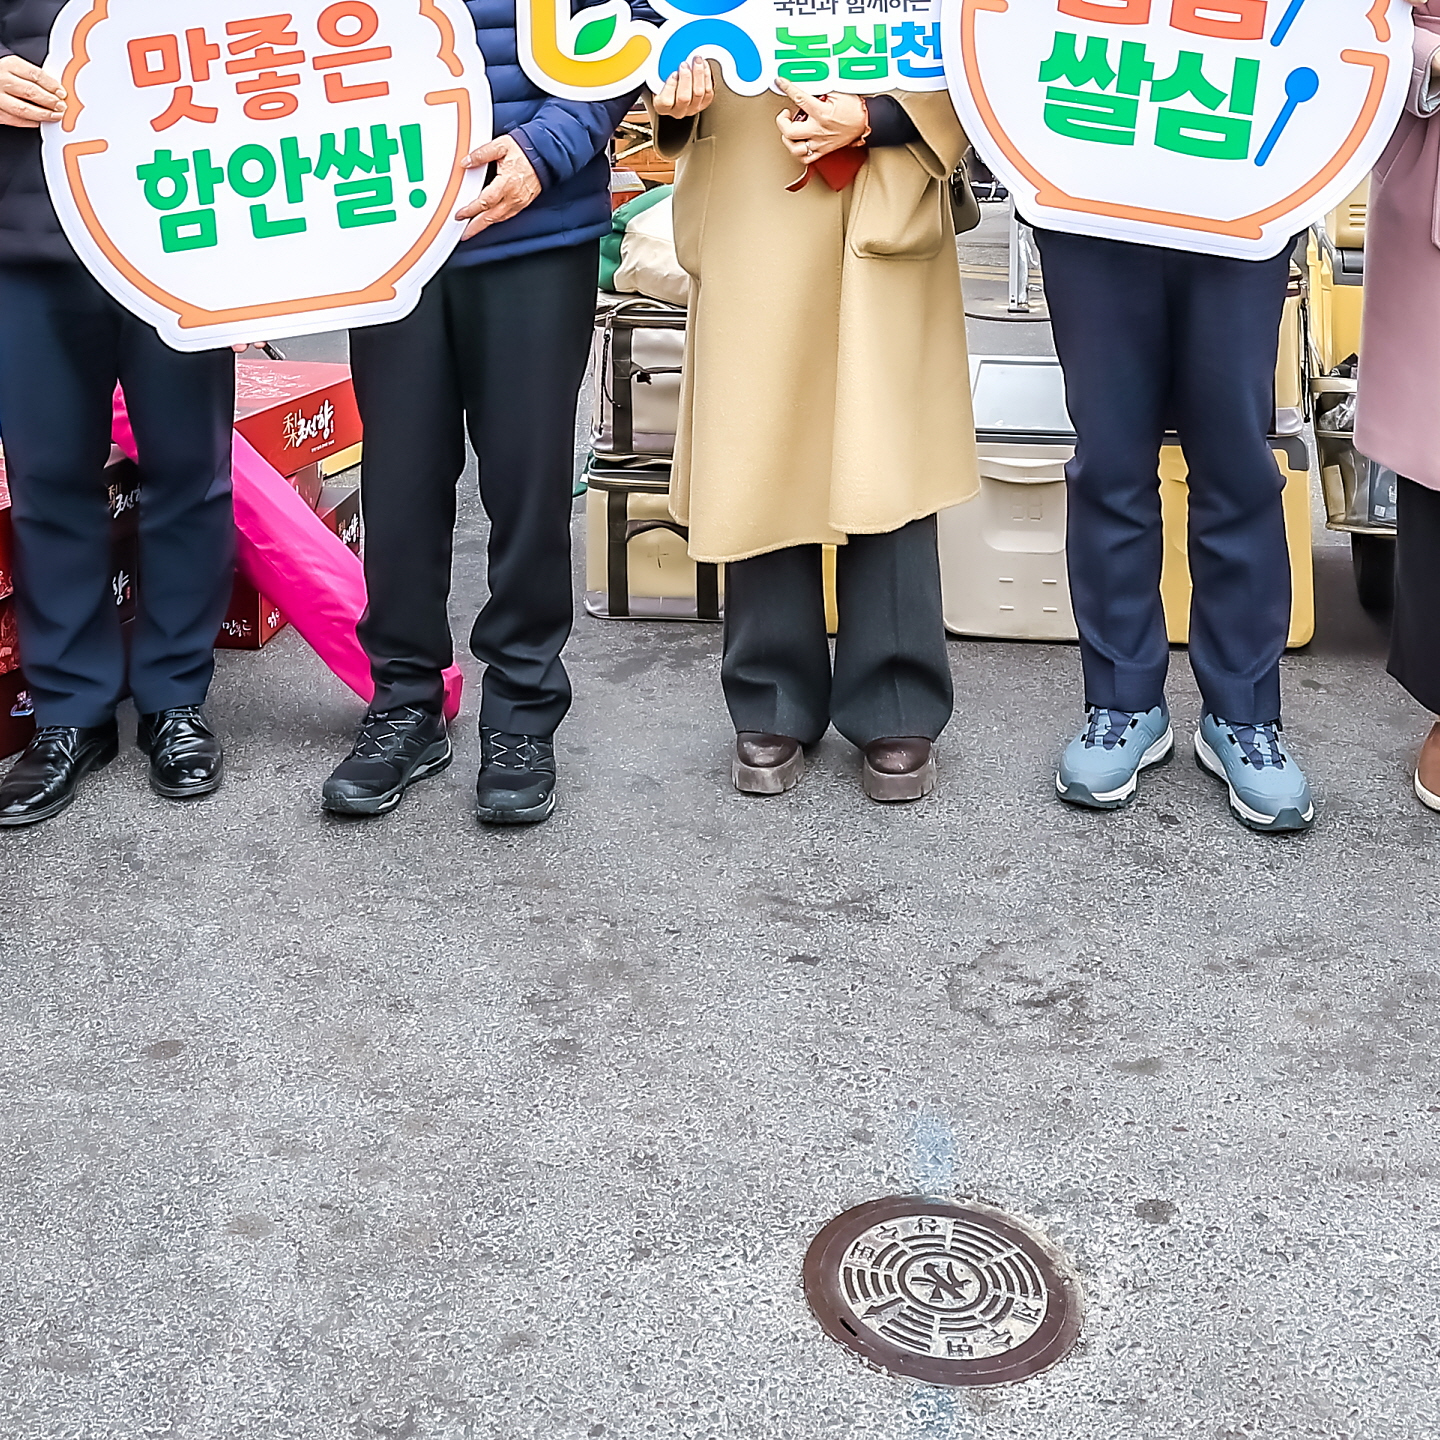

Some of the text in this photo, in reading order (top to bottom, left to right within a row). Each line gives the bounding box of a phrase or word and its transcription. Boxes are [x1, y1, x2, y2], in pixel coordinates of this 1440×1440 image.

[127, 0, 392, 132] 맛좋은
[1037, 30, 1261, 161] 쌀심
[136, 123, 427, 253] 함안쌀!
